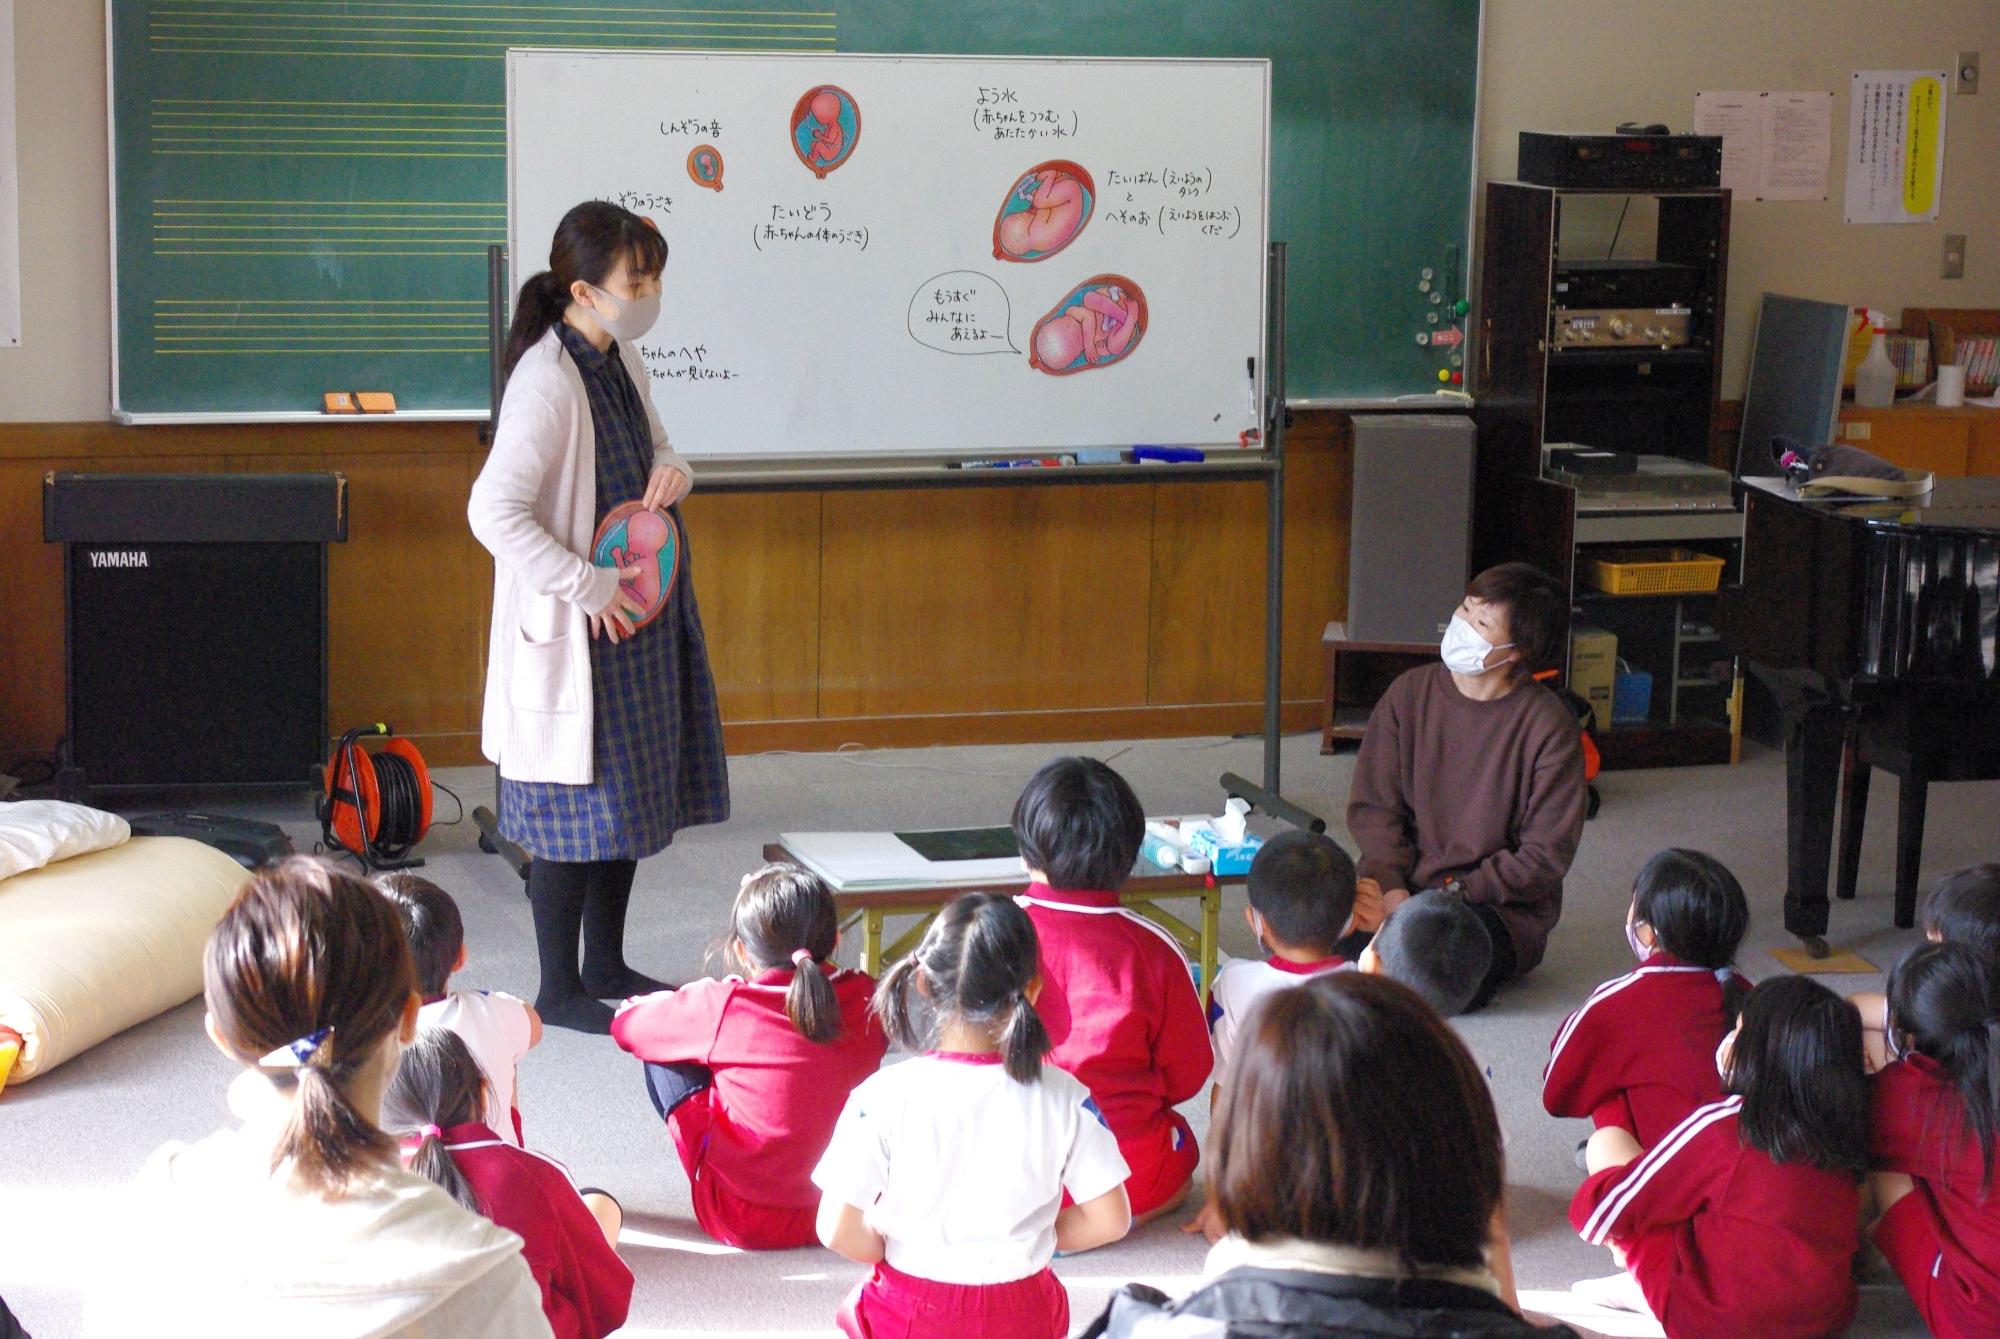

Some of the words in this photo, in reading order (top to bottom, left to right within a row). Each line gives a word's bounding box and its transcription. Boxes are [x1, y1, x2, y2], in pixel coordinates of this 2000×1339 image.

[976, 86, 1019, 105] よう水
[660, 118, 722, 138] しんぞうの音
[595, 190, 673, 213] ぞうのうごき
[1126, 191, 1135, 202] と
[772, 202, 832, 222] たいどう
[1105, 209, 1151, 226] へそのお
[933, 288, 976, 305] もうすぐ
[926, 309, 976, 324] みんなに
[950, 326, 1004, 341] あえるよー
[89, 551, 149, 568] YAMAHA
